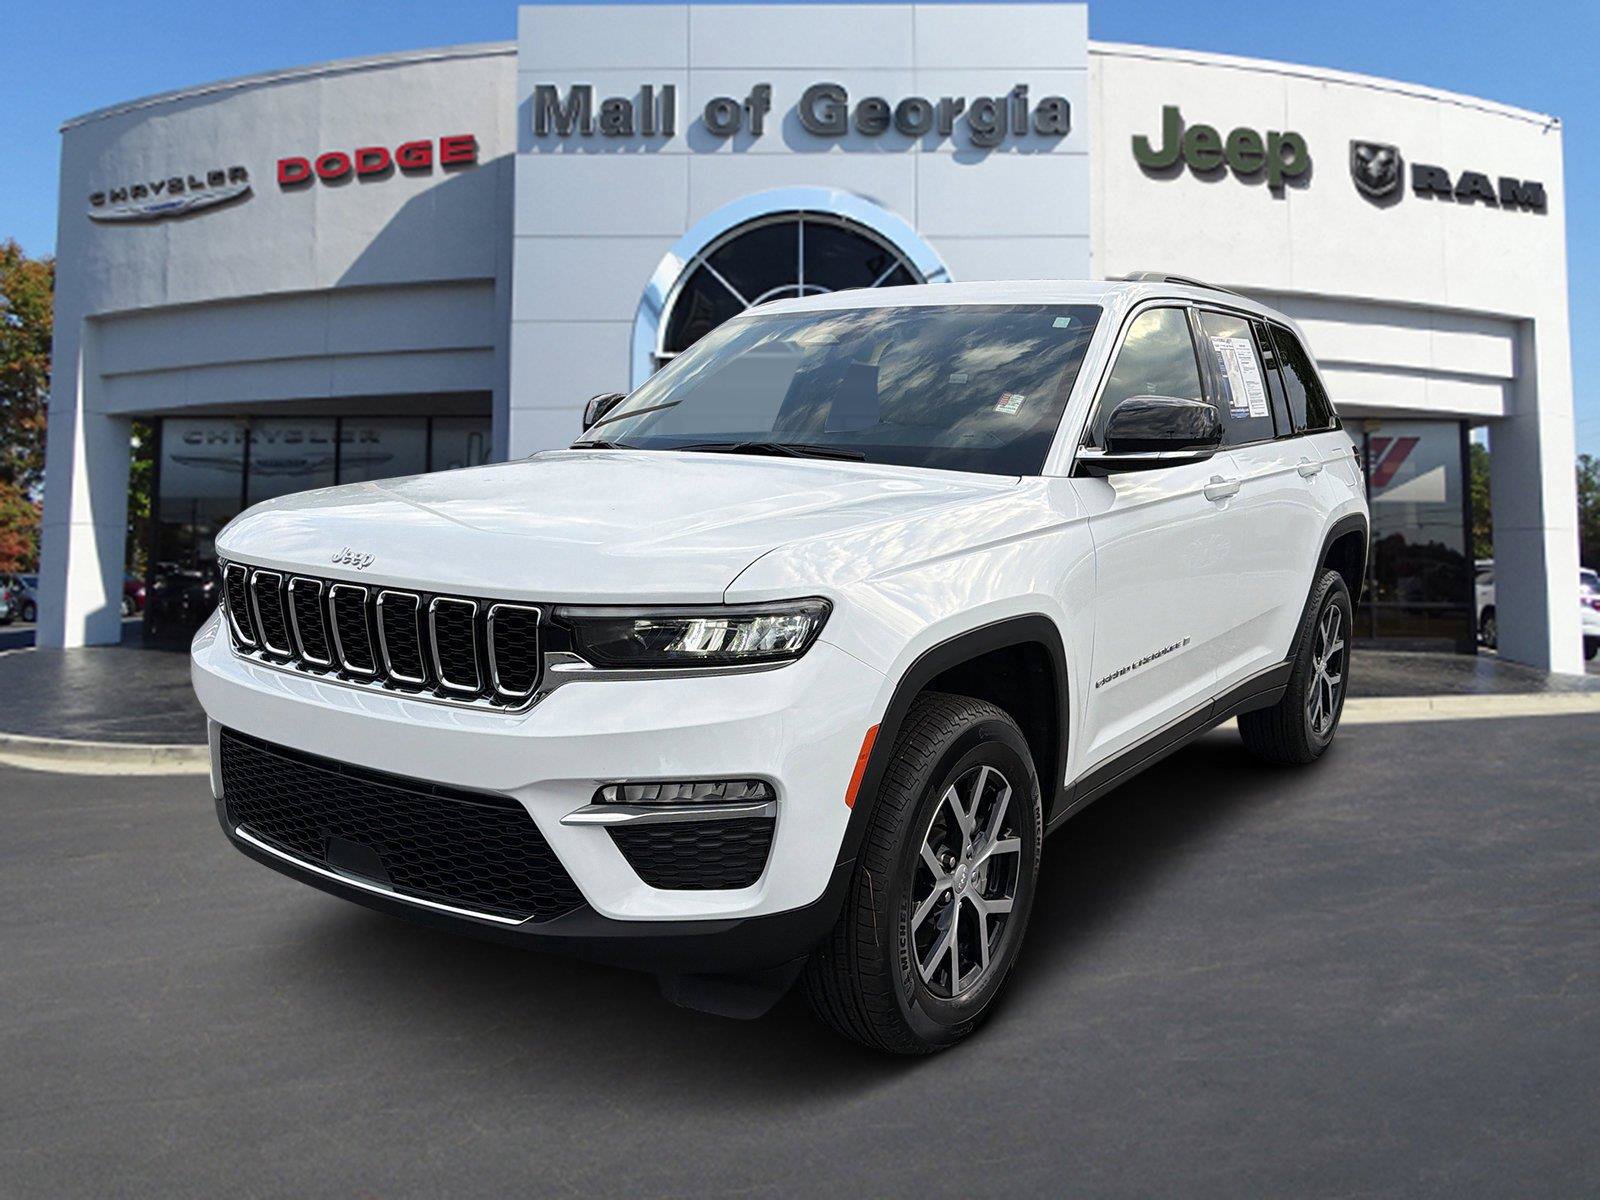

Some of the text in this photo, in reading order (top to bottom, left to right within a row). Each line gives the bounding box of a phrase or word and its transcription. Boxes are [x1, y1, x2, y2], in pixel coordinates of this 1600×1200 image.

[533, 83, 1071, 148] Mall of Georgia
[277, 135, 477, 186] DODGE
[1131, 105, 1309, 189] Jeep
[89, 166, 248, 206] CHRYSLER
[1411, 163, 1547, 212] RAM
[183, 430, 381, 444] CHRYSLER
[331, 546, 376, 571] Jeep
